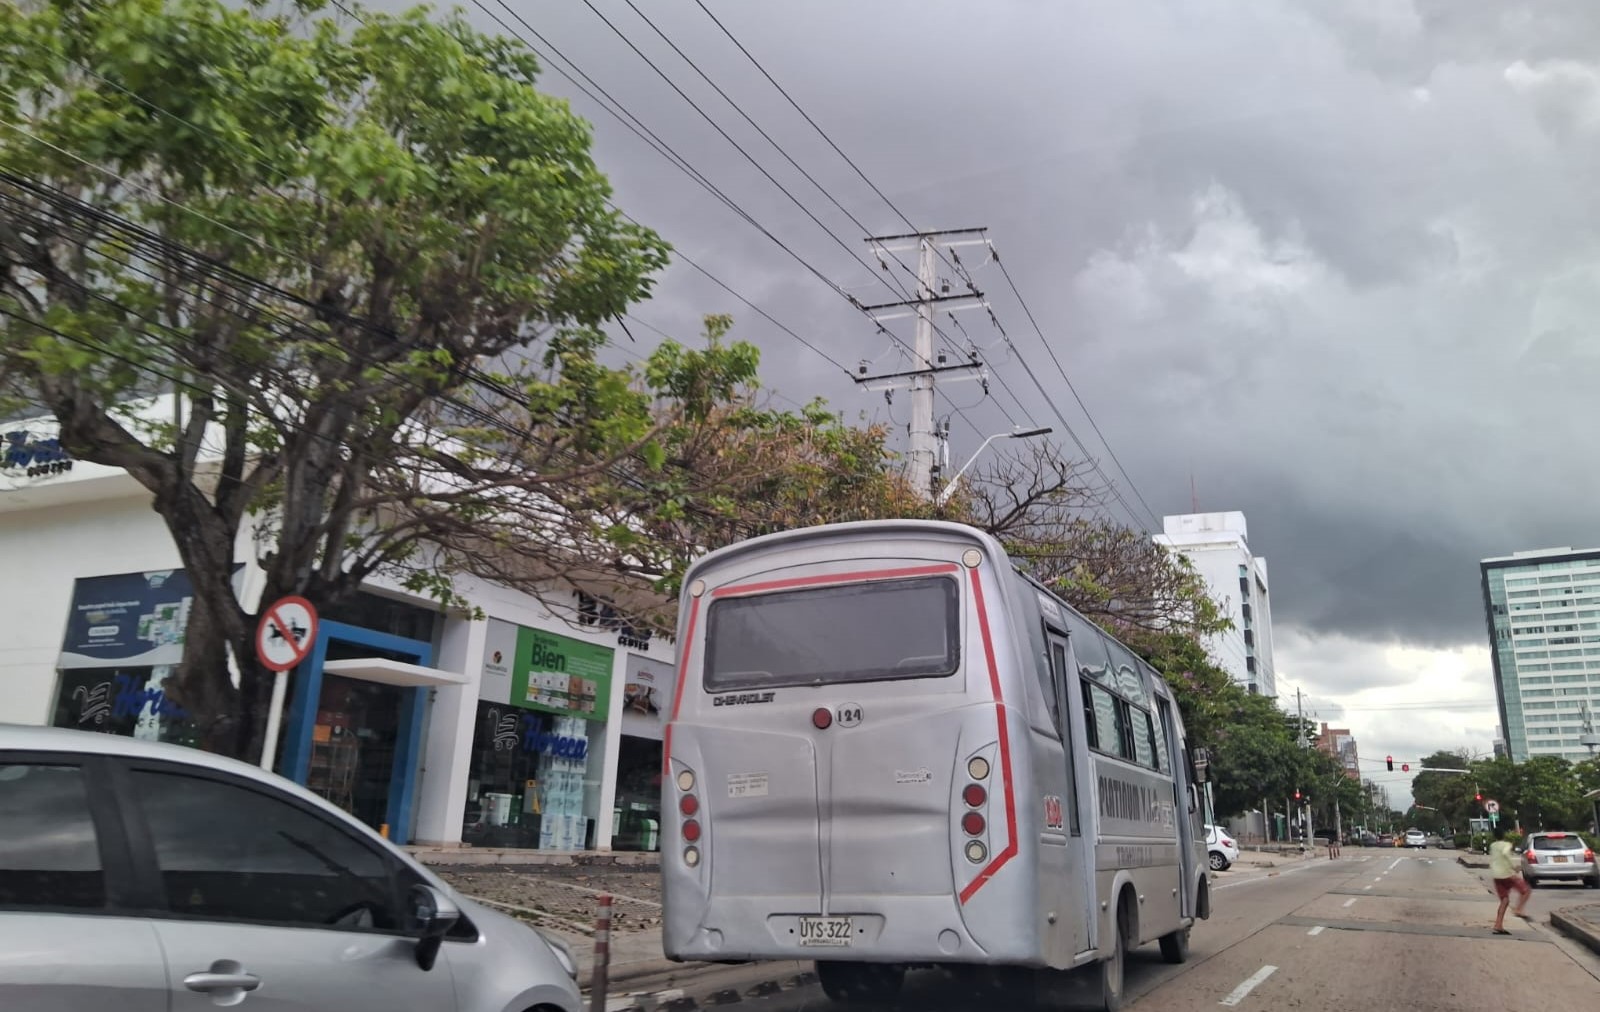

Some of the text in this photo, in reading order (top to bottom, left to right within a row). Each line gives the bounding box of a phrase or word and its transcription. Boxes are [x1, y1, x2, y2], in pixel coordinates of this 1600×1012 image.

[531, 643, 566, 672] Bien
[713, 692, 776, 706] CHEVROLET
[838, 708, 861, 722] 124
[1098, 775, 1140, 821] PLATINUM
